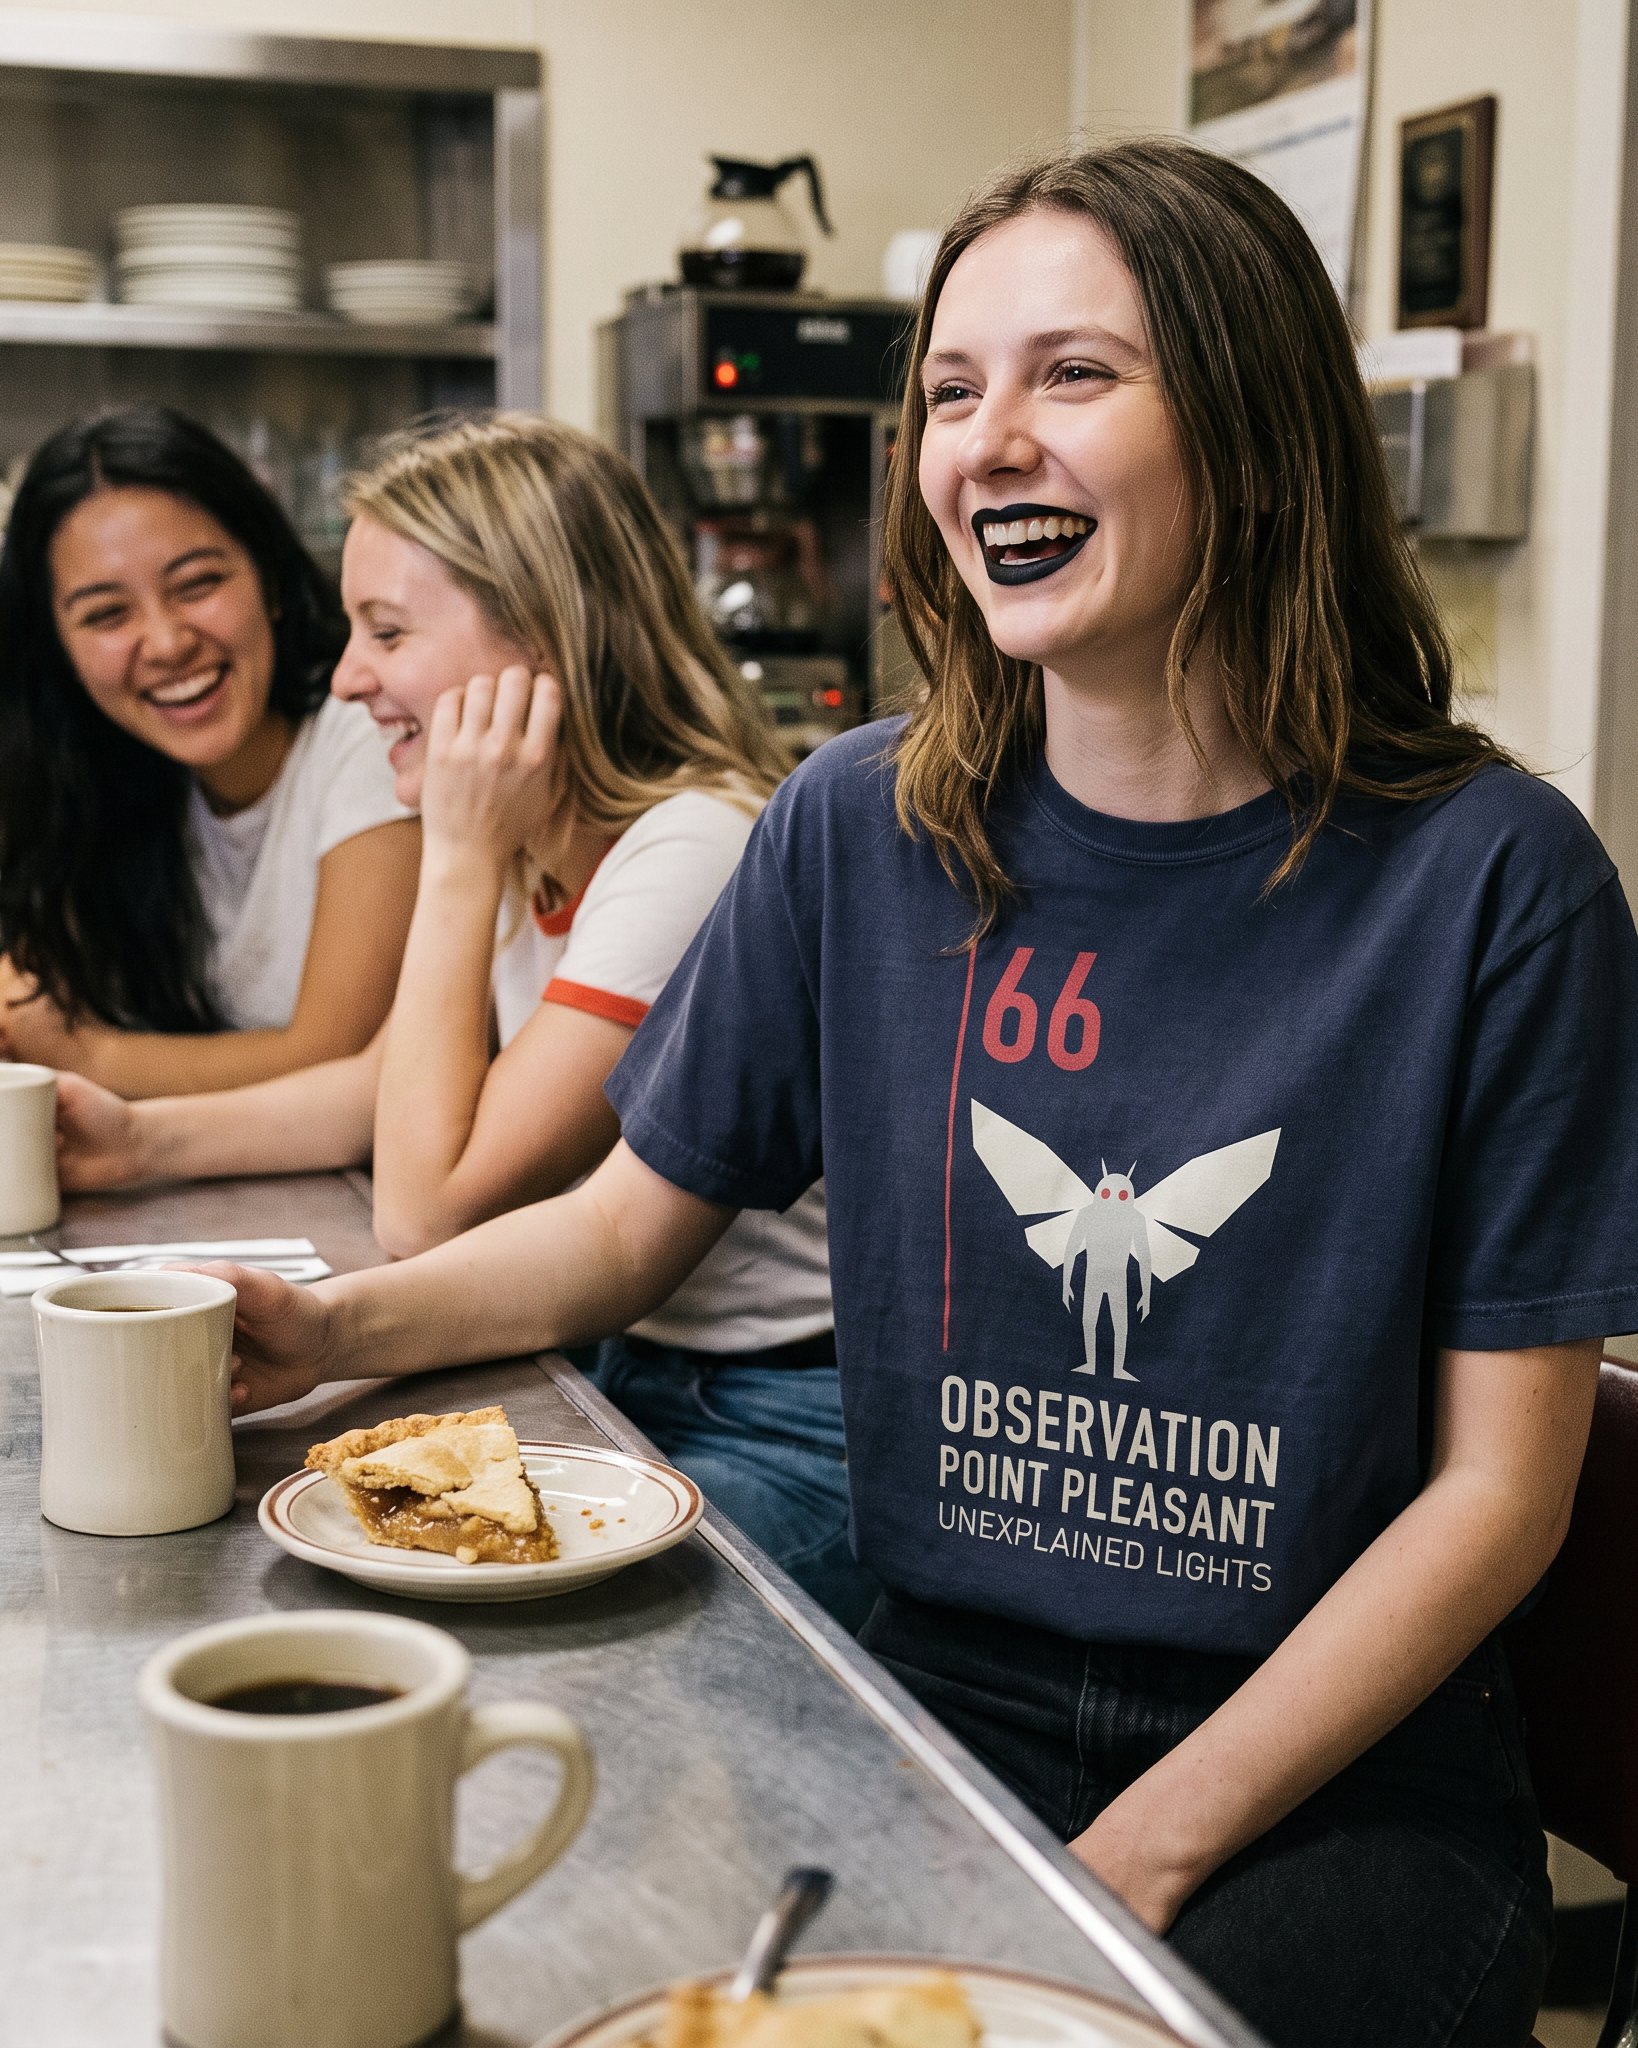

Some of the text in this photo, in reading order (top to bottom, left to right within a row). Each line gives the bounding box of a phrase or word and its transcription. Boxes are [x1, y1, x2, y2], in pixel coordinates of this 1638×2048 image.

[982, 946, 1102, 1072] 66
[941, 1375, 1281, 1488] OBSERVATION
[938, 1501, 1273, 1592] UNEXPLAINED LIGHTS
[939, 1444, 1276, 1549] POINT PLEASANT
